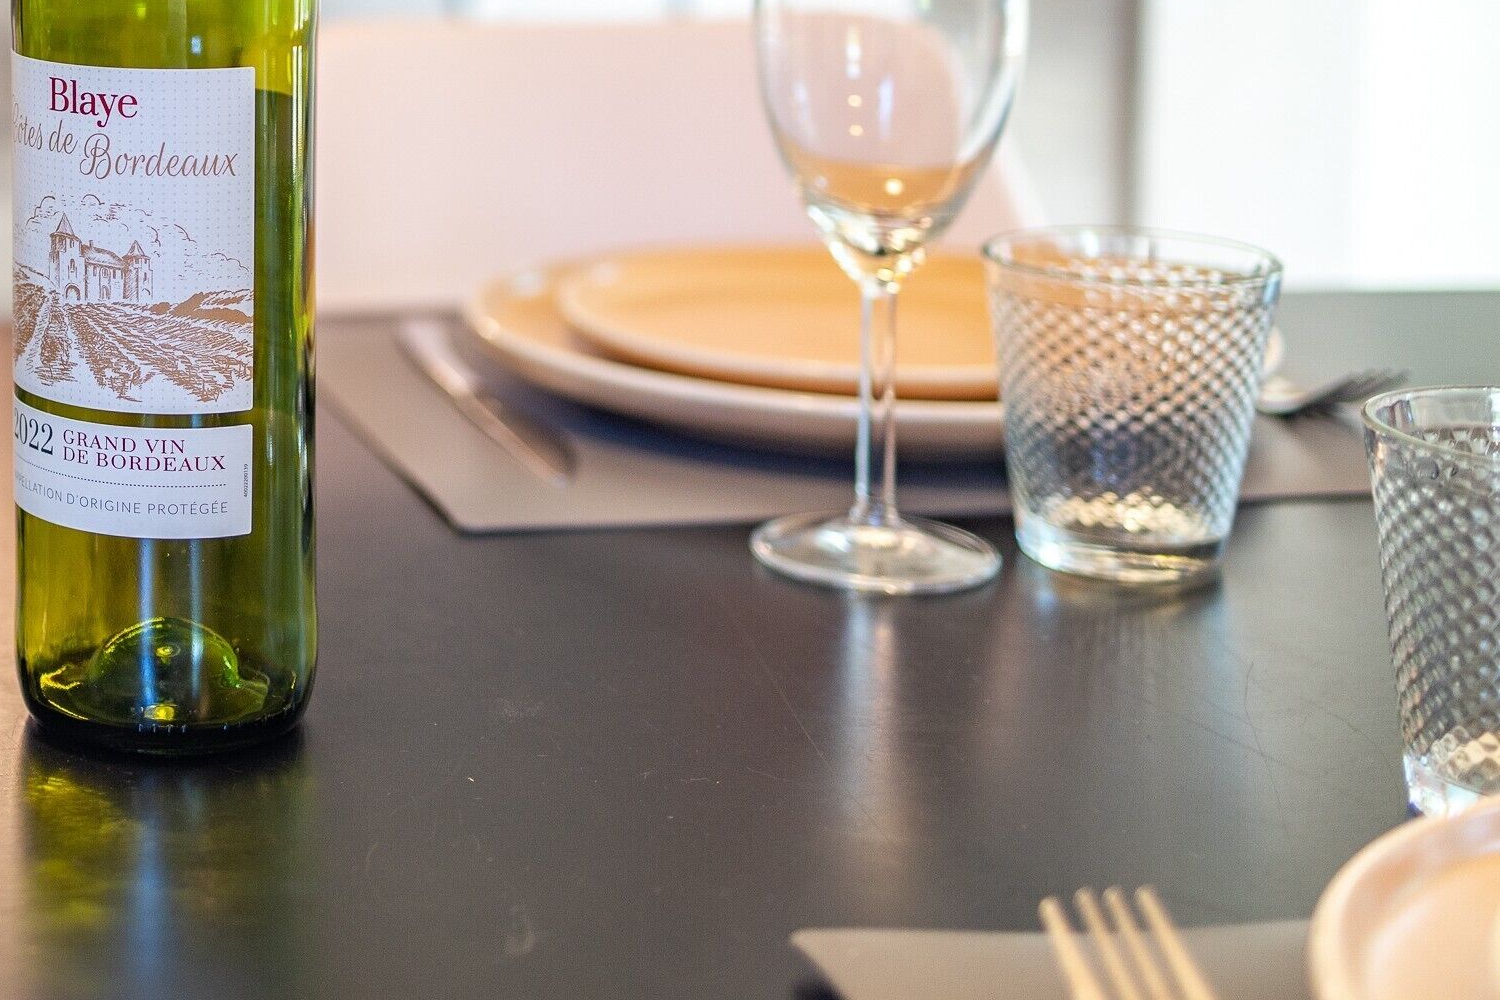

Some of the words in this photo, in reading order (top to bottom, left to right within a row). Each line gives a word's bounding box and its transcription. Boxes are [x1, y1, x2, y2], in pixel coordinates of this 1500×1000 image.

[49, 76, 138, 128] Blaye
[48, 119, 78, 155] de
[79, 132, 238, 180] Bordeaux
[63, 428, 137, 453] GRAND
[145, 438, 186, 455] VIN
[63, 445, 89, 466] DE
[96, 453, 226, 472] BORDEAUX
[14, 471, 62, 503] PELLATION
[66, 492, 141, 515] D'ORIGINE
[147, 500, 229, 516] PROTÉGÉE
